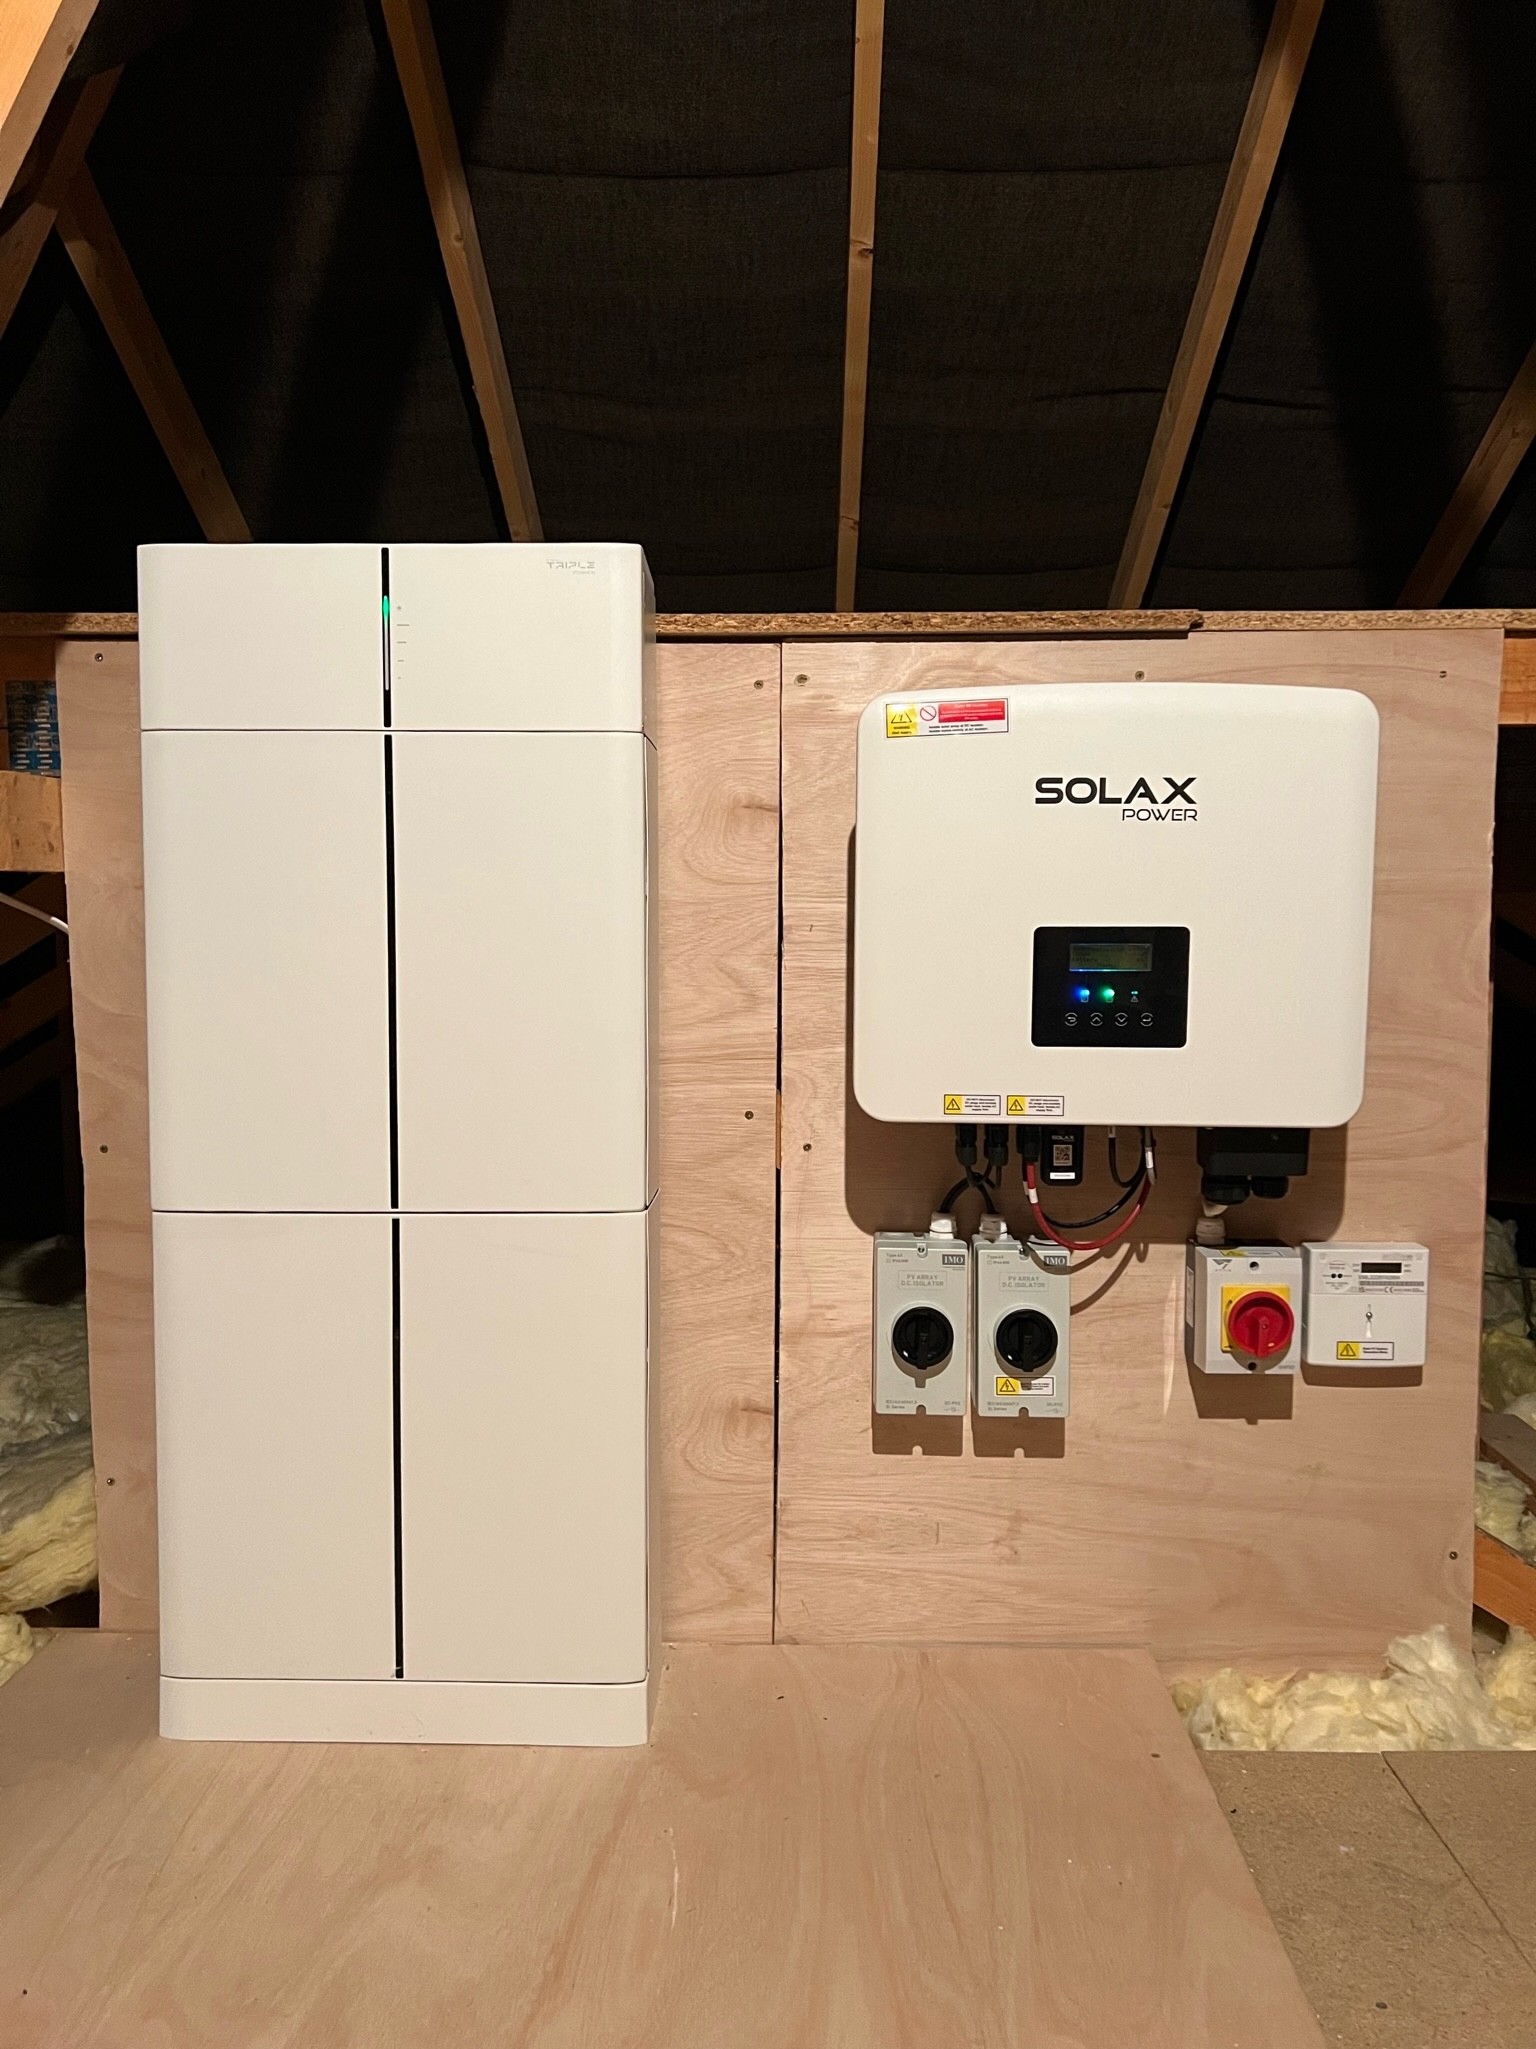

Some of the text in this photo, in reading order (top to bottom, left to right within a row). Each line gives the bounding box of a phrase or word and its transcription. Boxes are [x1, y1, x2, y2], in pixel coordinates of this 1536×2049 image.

[1035, 777, 1197, 804] SOLAX
[1122, 809, 1198, 821] POWER
[944, 1255, 964, 1264] IMO
[1046, 1256, 1066, 1265] IMO
